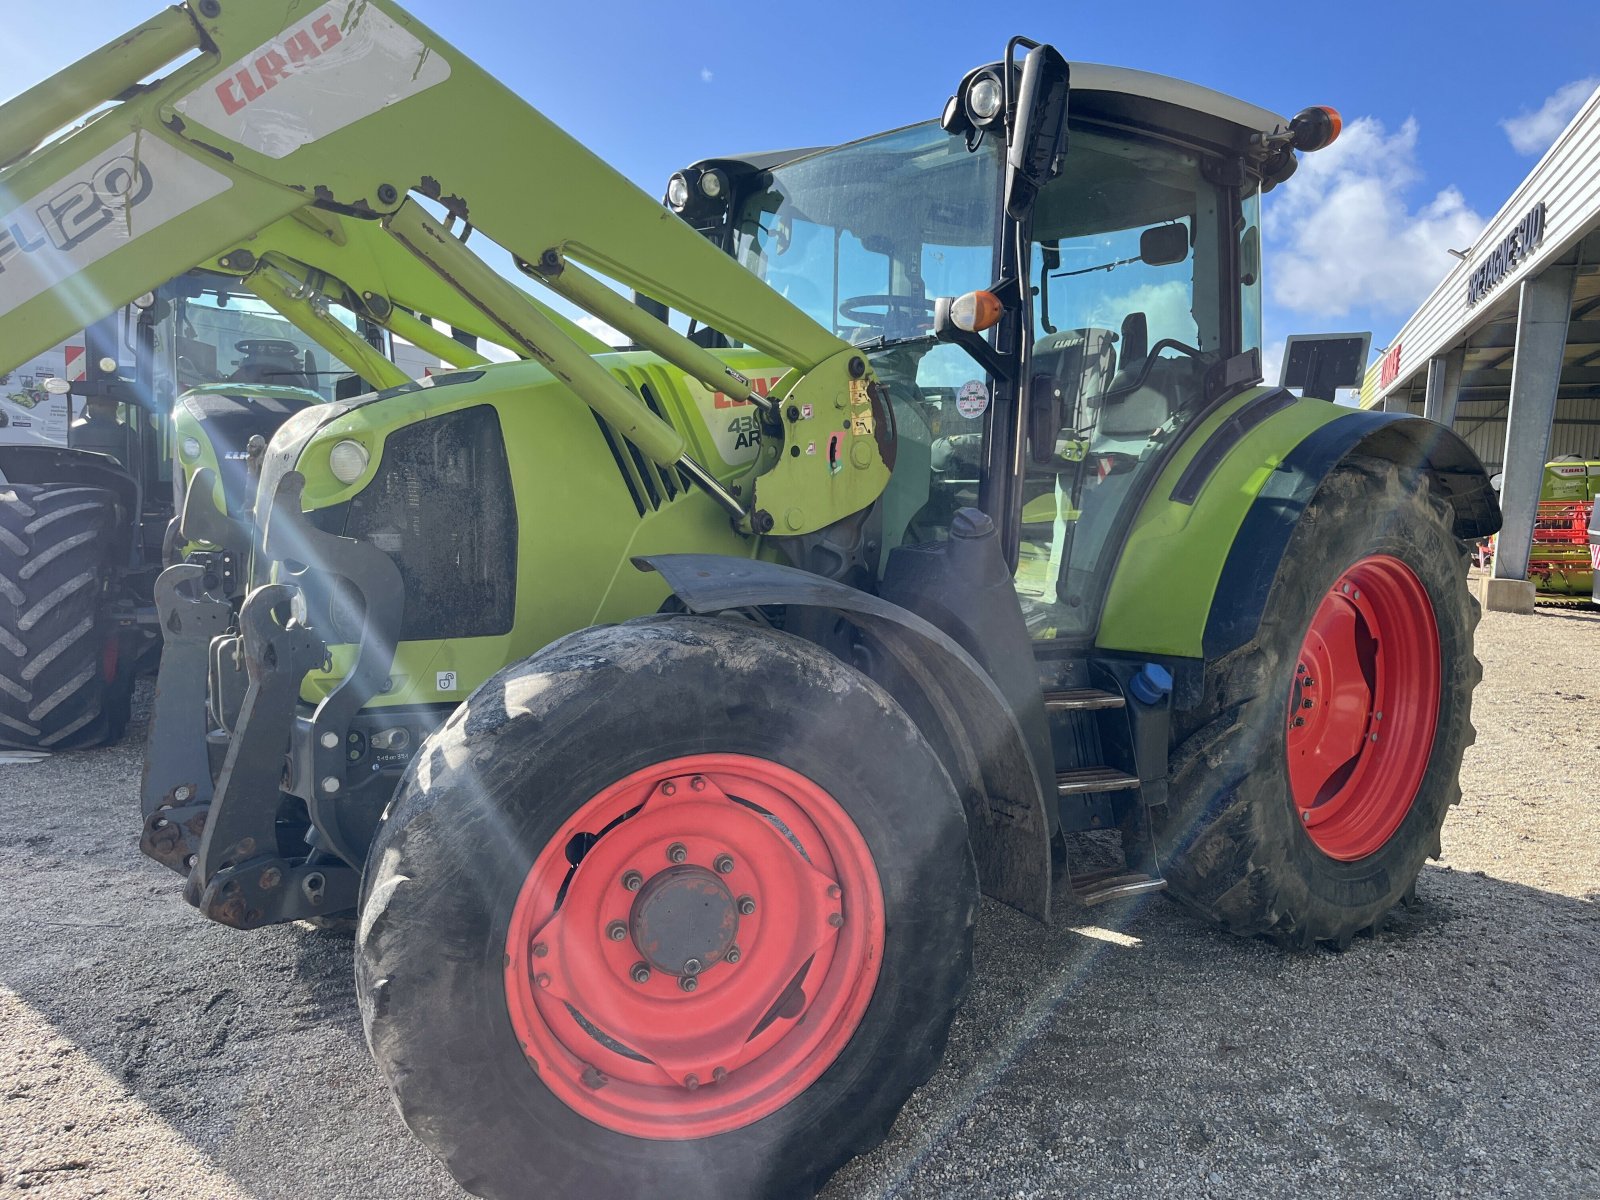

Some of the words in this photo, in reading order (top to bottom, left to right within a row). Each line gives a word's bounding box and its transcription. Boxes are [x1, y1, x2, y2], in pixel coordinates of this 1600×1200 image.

[215, 13, 342, 116] CLAAS
[36, 156, 154, 252] 120
[1466, 226, 1519, 306] BRETAGNE
[1515, 201, 1545, 260] SUD
